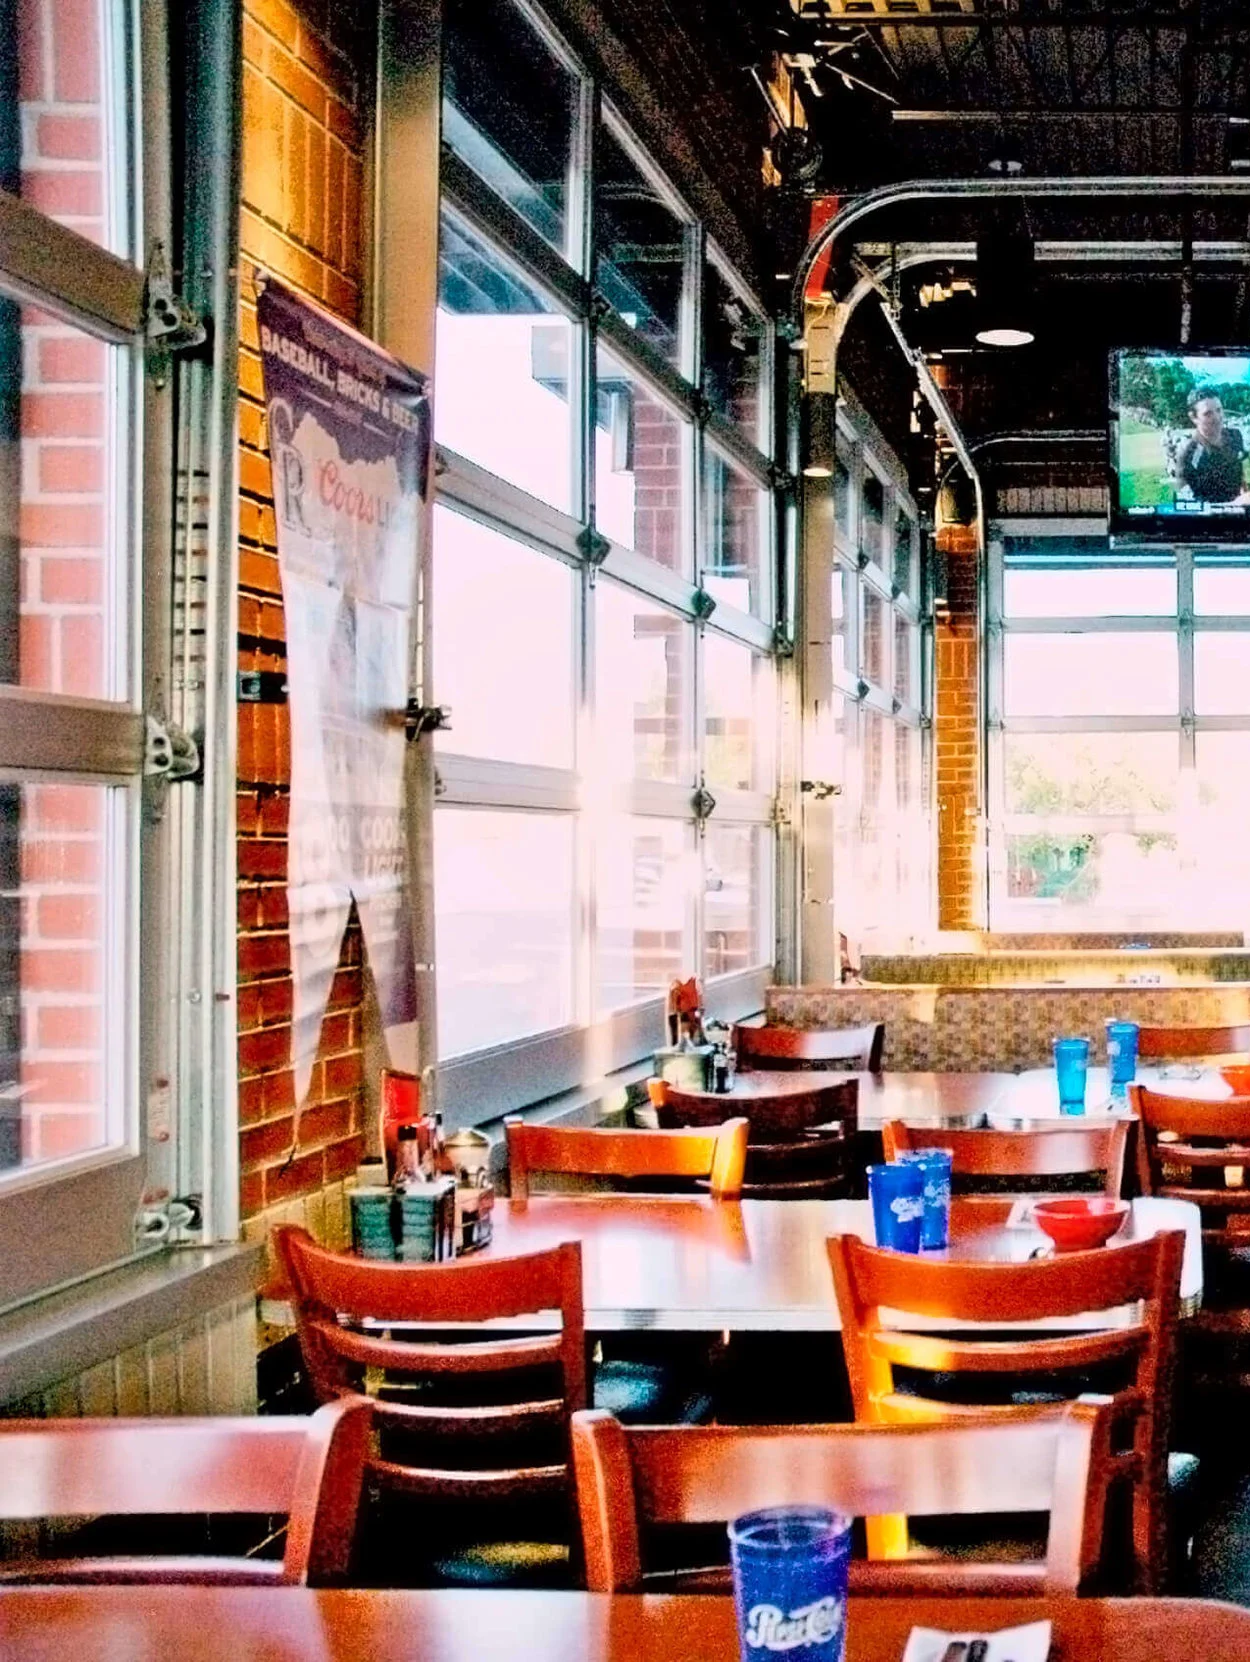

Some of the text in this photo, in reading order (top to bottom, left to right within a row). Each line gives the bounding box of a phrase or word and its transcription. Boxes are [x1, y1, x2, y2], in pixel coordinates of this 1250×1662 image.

[337, 370, 380, 413] BRICKS
[392, 402, 419, 436] BEER
[318, 459, 374, 526] Coors
